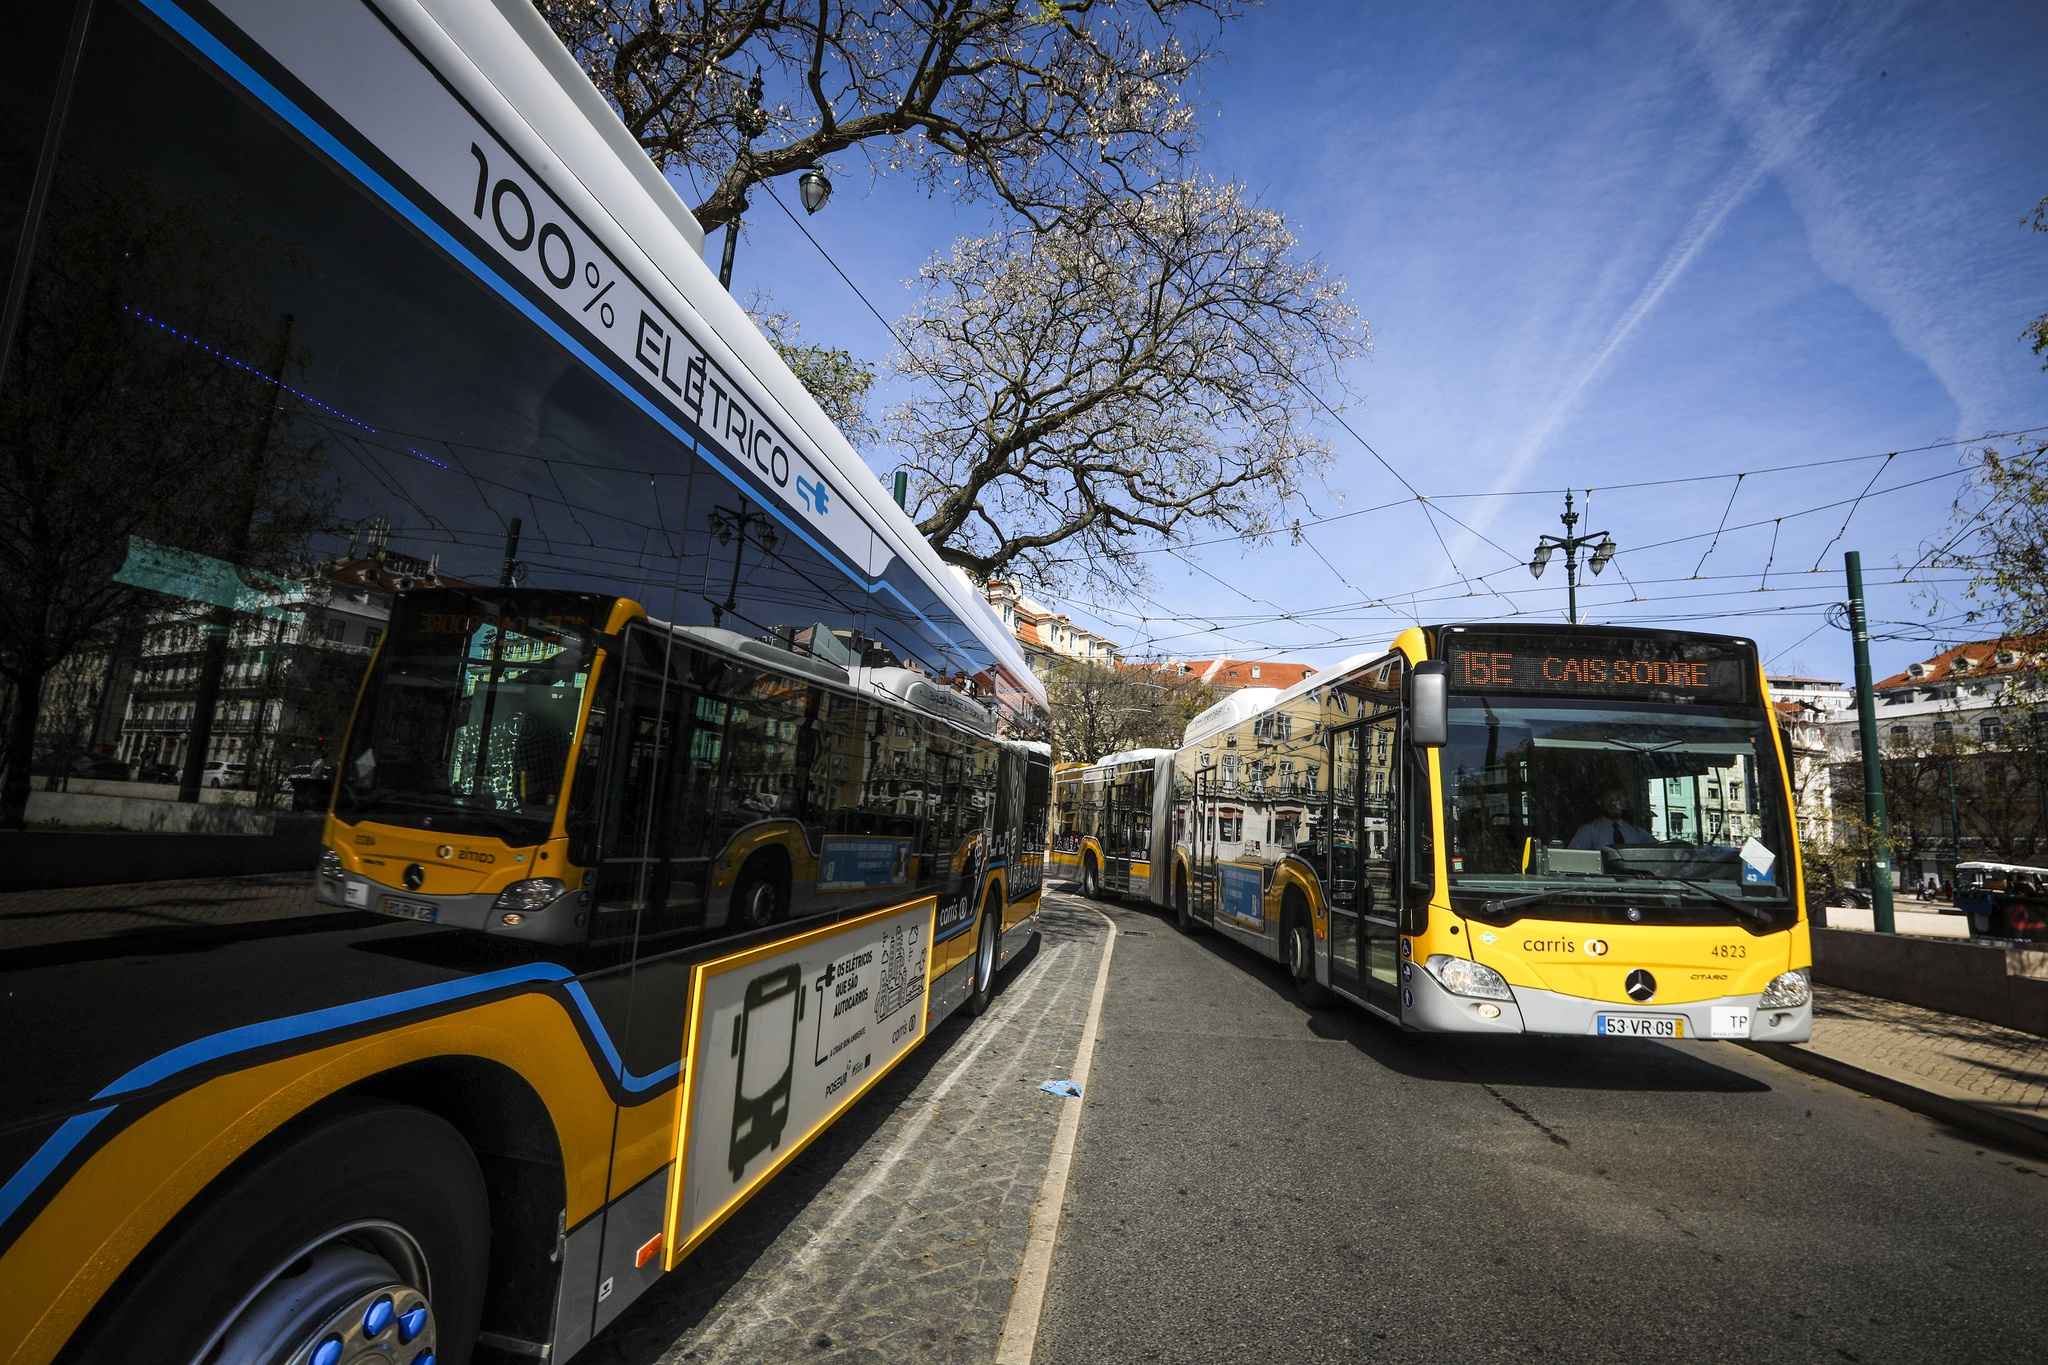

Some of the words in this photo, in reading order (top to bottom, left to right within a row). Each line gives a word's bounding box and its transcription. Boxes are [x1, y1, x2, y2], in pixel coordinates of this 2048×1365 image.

[471, 141, 616, 330] 100%
[635, 309, 790, 488] ELÉTRICO
[1457, 651, 1513, 685] 15E
[1542, 657, 1607, 683] CAIS
[1614, 660, 1709, 687] SODRE
[939, 897, 958, 927] carris
[1523, 936, 1575, 953] carris
[1711, 944, 1747, 958] 4823
[837, 962, 845, 978] OS
[845, 950, 873, 974] ELÉTRICOS
[1690, 973, 1728, 981] CITARO
[835, 980, 847, 998] QUE
[847, 972, 858, 992] SÃO
[833, 987, 869, 1019] AUTOCARROS
[1730, 1015, 1748, 1028] TP
